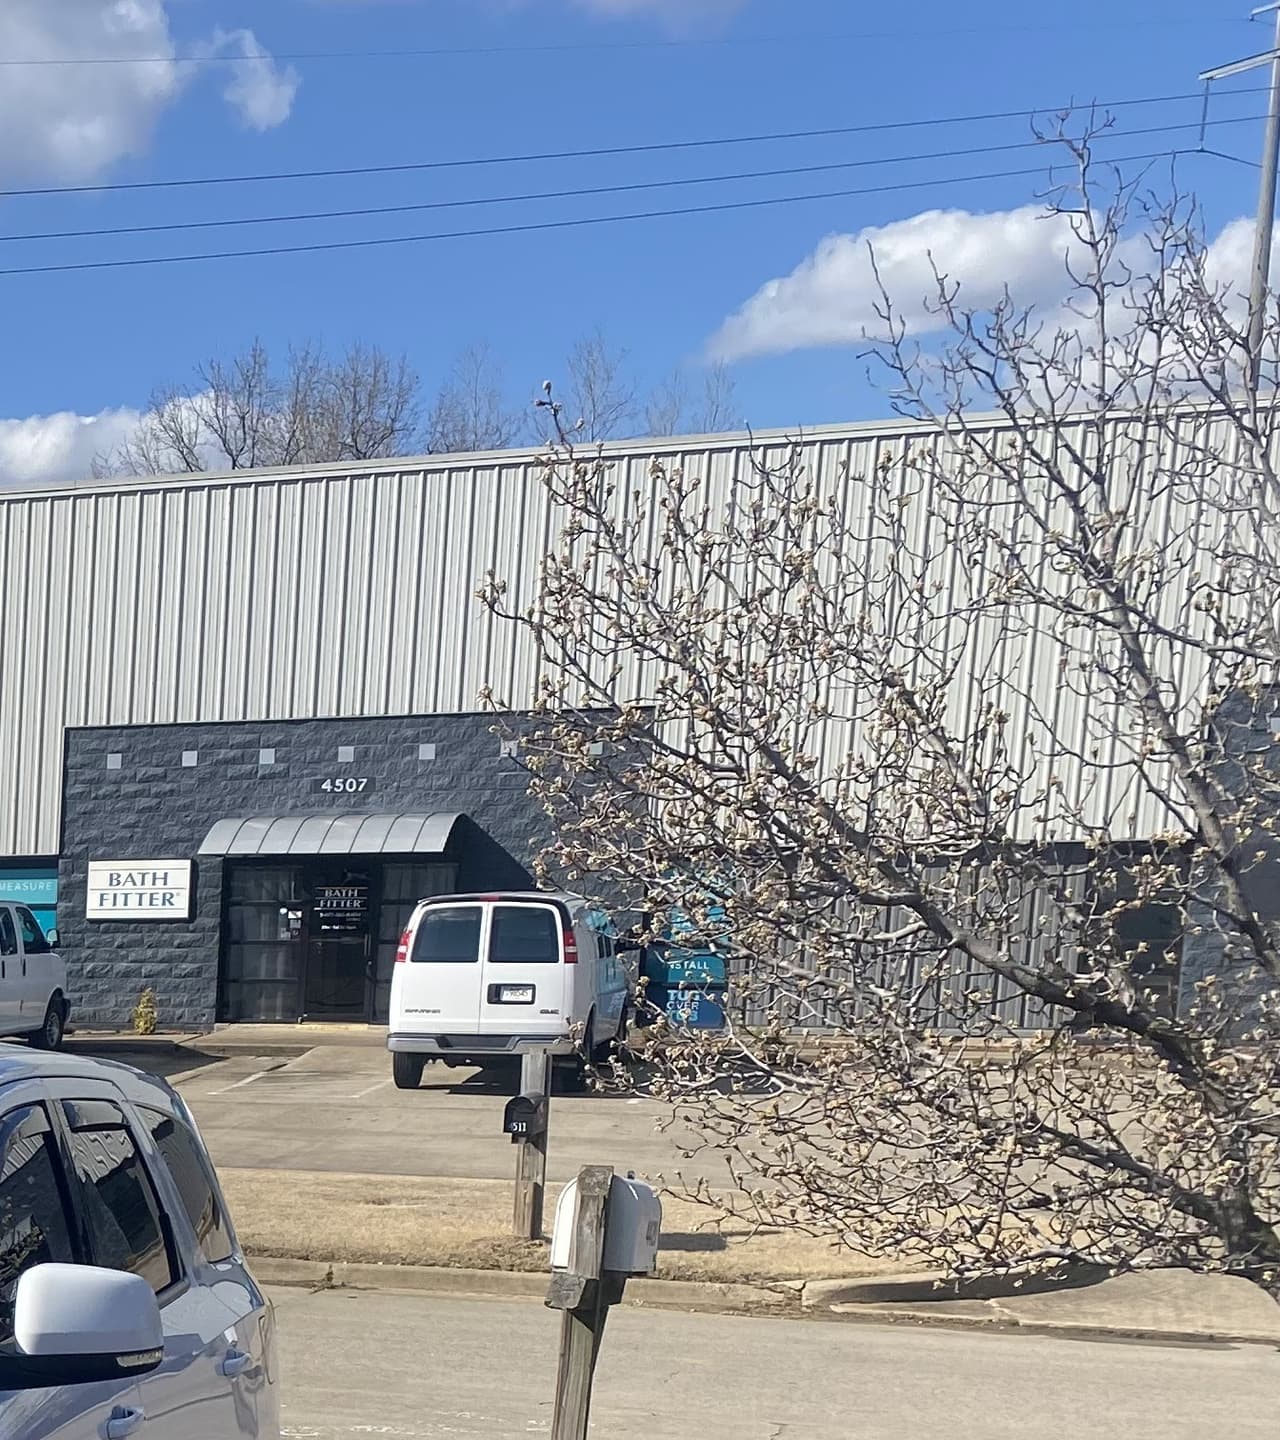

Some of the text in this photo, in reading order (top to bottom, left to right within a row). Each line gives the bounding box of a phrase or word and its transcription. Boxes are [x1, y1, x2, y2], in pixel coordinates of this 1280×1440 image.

[321, 778, 368, 792] 4507
[108, 872, 169, 887] BATH
[98, 891, 175, 907] FITTER
[324, 889, 358, 897] BATH
[668, 961, 710, 970] NSTALL
